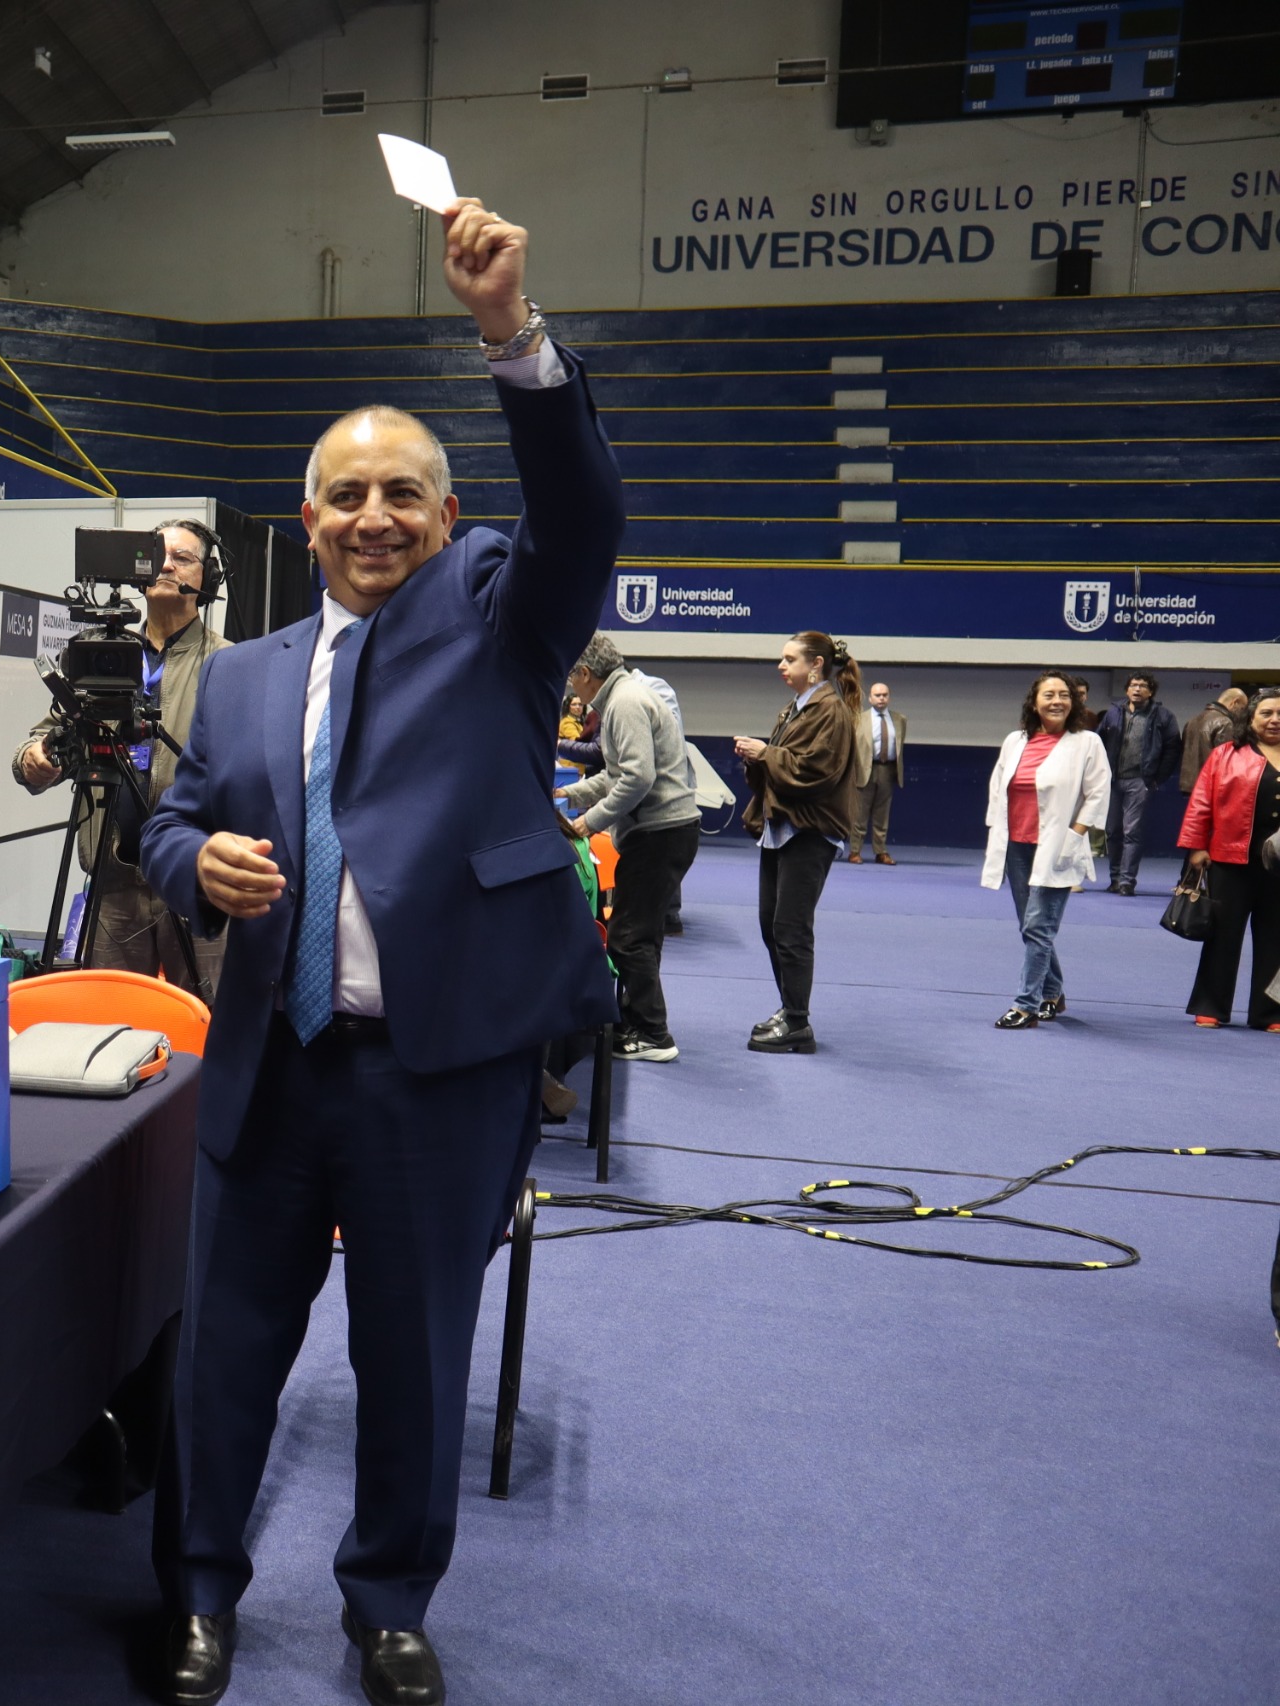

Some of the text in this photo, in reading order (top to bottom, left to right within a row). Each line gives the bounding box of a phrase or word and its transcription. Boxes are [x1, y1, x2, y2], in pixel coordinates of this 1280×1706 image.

[1034, 33, 1074, 47] periodo
[1148, 49, 1174, 60] faltas
[970, 63, 995, 75] faltas
[1040, 58, 1072, 70] jugador
[1053, 94, 1080, 105] juego
[691, 196, 775, 222] GANA
[810, 192, 857, 218] SIN
[886, 185, 1033, 215] ORGULLO
[1062, 175, 1187, 207] PIERDE
[652, 210, 1280, 274] UNIVERSIDAD DE CON
[662, 587, 734, 601] Universidad
[1115, 593, 1197, 608] Universidad
[661, 602, 751, 619] de Concepción
[6, 612, 33, 637] MESA 3
[43, 612, 65, 630] GUZMÁN
[1114, 610, 1216, 627] de Concepción
